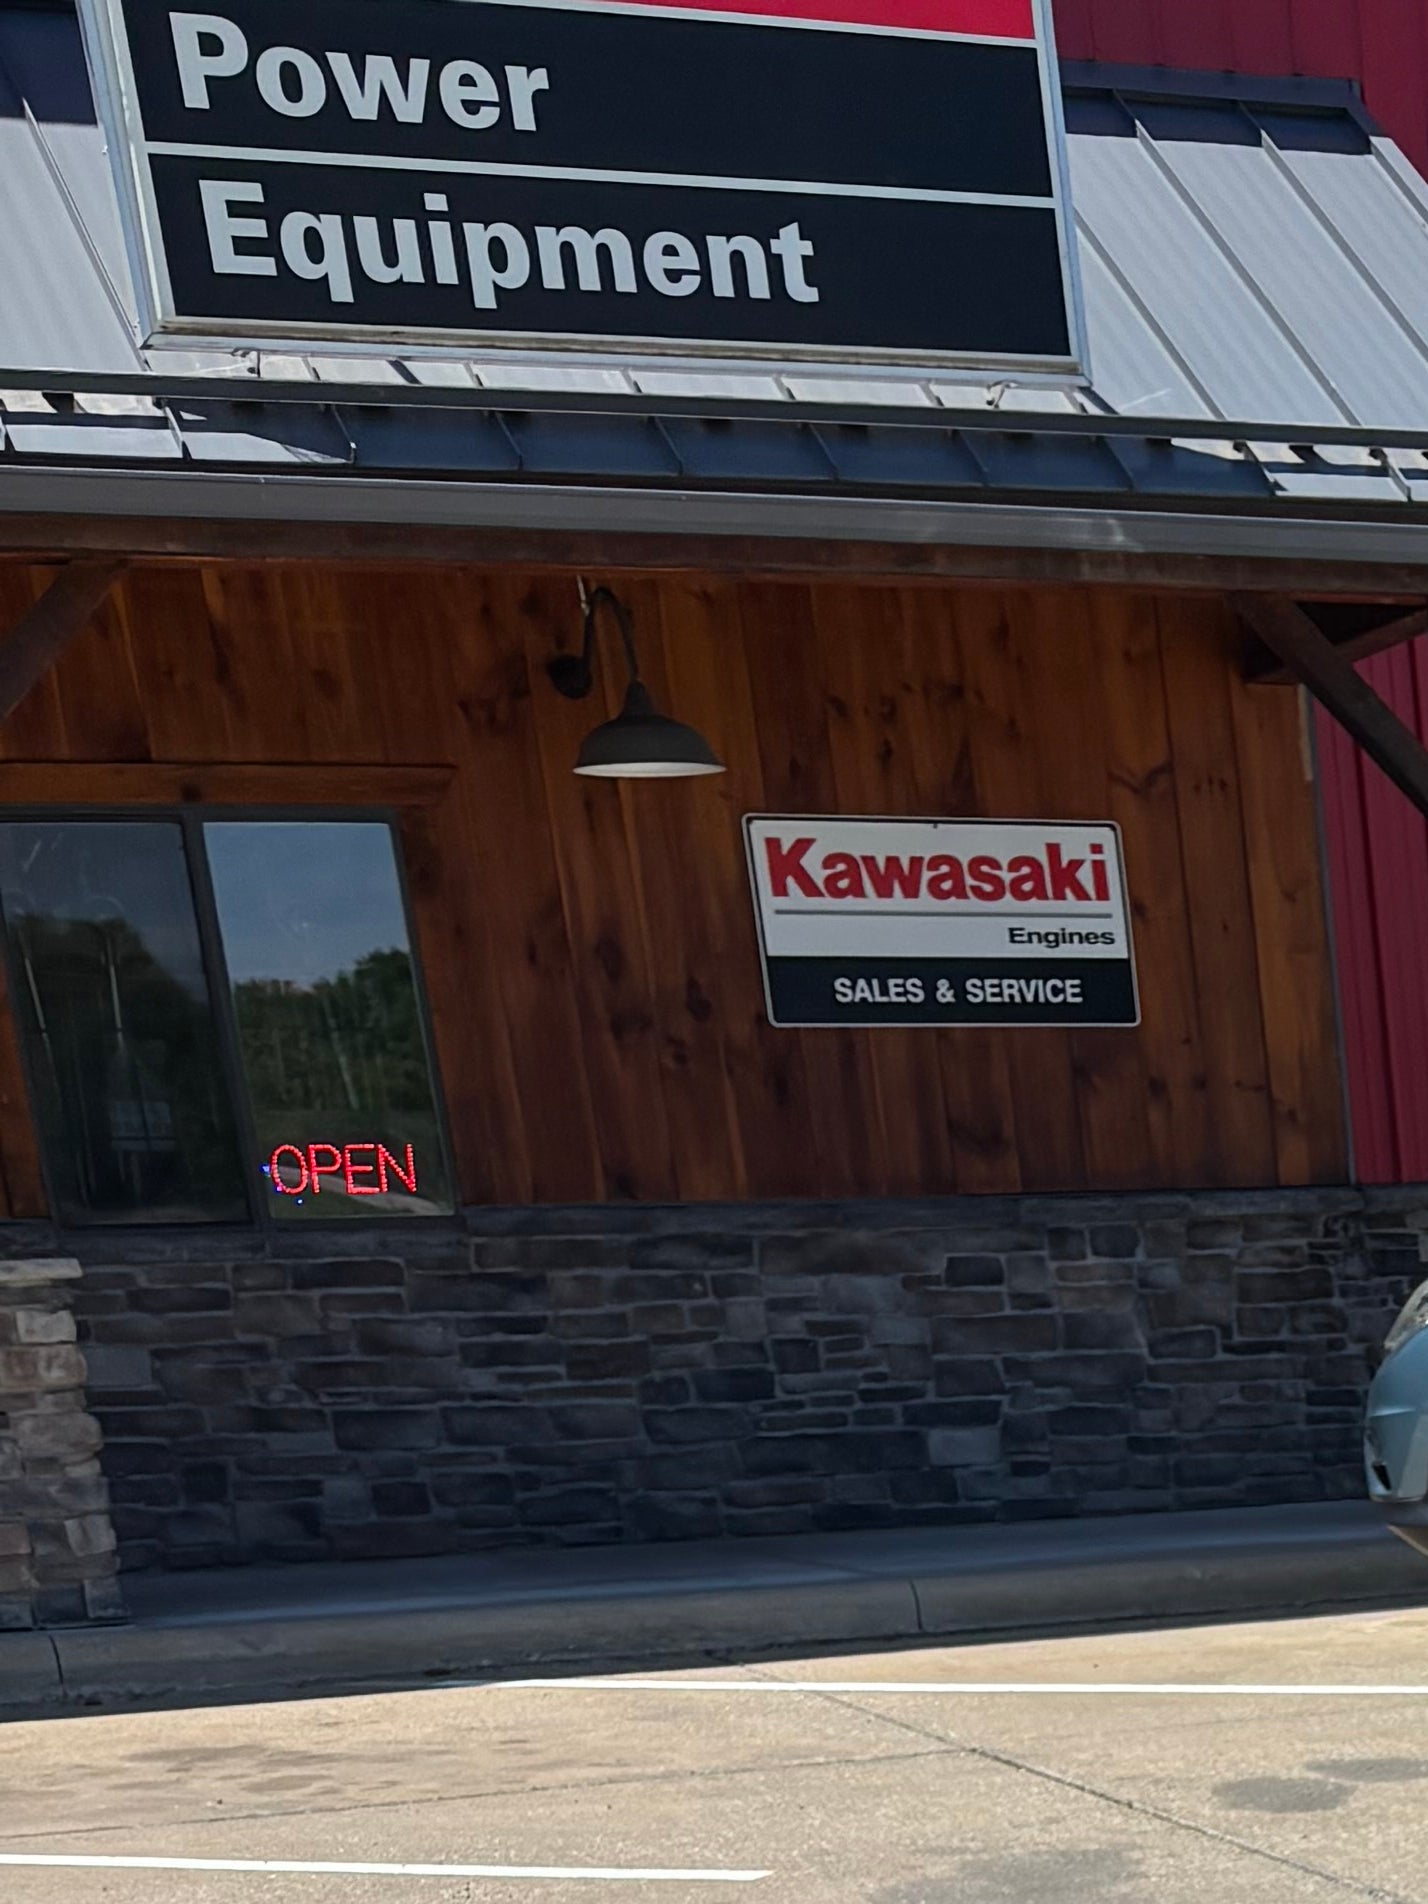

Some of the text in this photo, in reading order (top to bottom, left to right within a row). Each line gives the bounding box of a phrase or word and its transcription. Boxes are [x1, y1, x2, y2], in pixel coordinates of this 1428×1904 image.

[168, 12, 550, 132] Power
[198, 179, 820, 309] Equipment
[764, 837, 1110, 901] Kawasaki
[1008, 927, 1115, 948] Engines
[833, 977, 1083, 1003] SALES & SERVICE
[269, 1143, 417, 1195] OPEN
